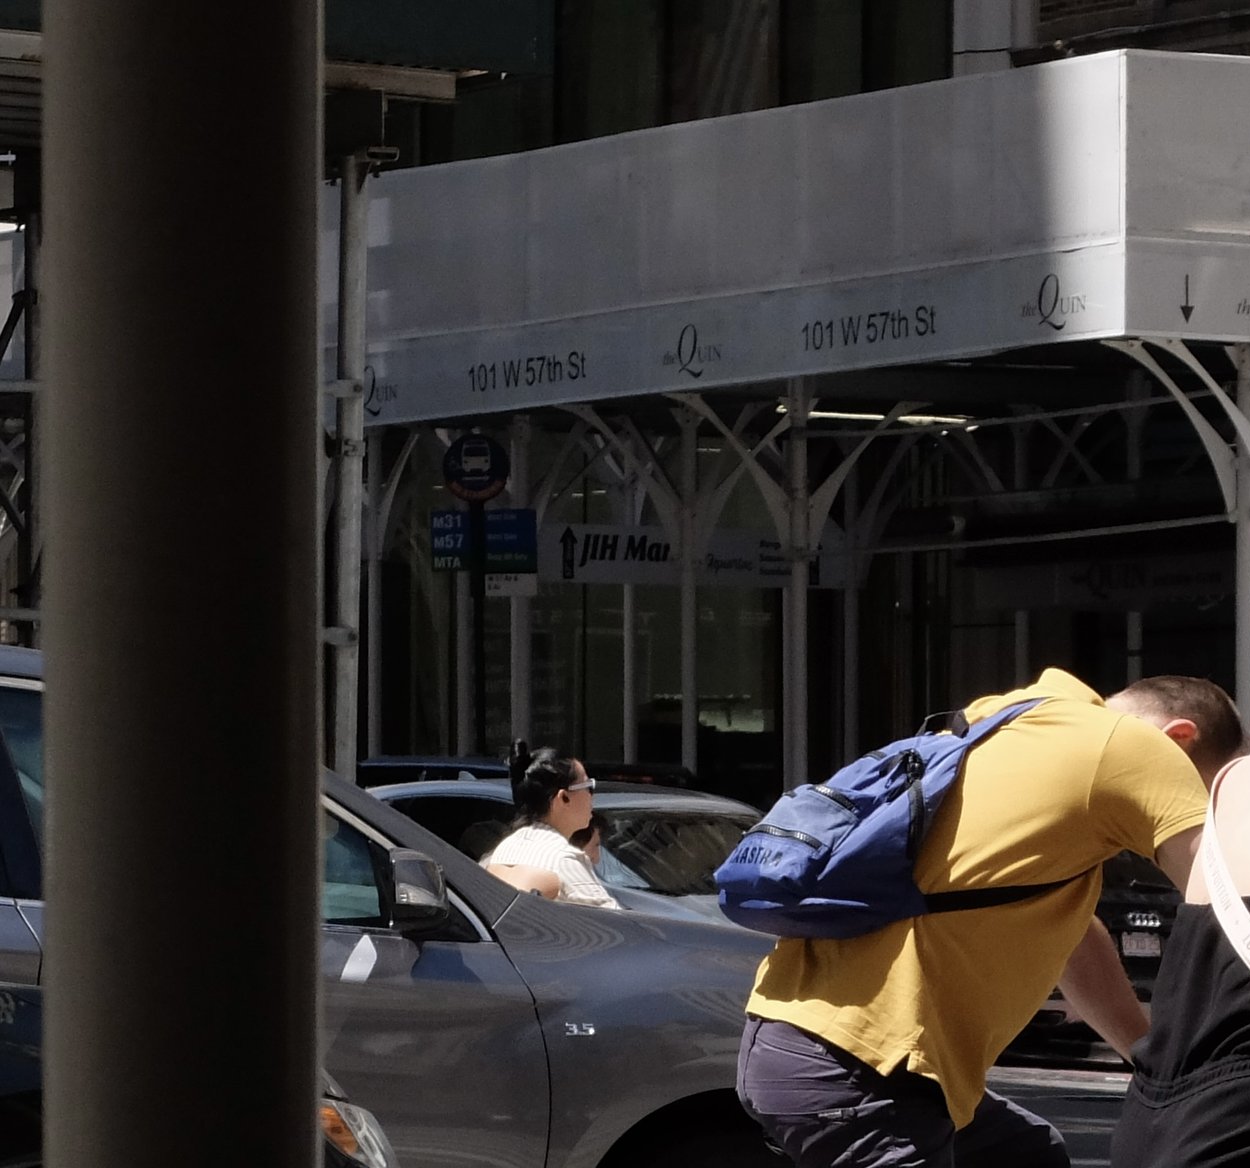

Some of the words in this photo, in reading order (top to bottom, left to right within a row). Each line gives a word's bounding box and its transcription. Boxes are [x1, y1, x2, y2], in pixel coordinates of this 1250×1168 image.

[1021, 302, 1037, 317] the
[1038, 273, 1087, 330] QUIN
[801, 321, 834, 352] 101
[841, 316, 863, 346] W
[866, 309, 910, 344] 57th
[915, 305, 938, 337] St
[677, 323, 723, 378] QUIN
[468, 363, 497, 392] 101
[503, 358, 522, 388] W
[525, 355, 563, 386] 57th
[567, 351, 587, 380] St
[432, 513, 462, 529] M31
[433, 533, 464, 549] M57
[579, 534, 619, 567] JIH
[433, 556, 462, 568] MTA
